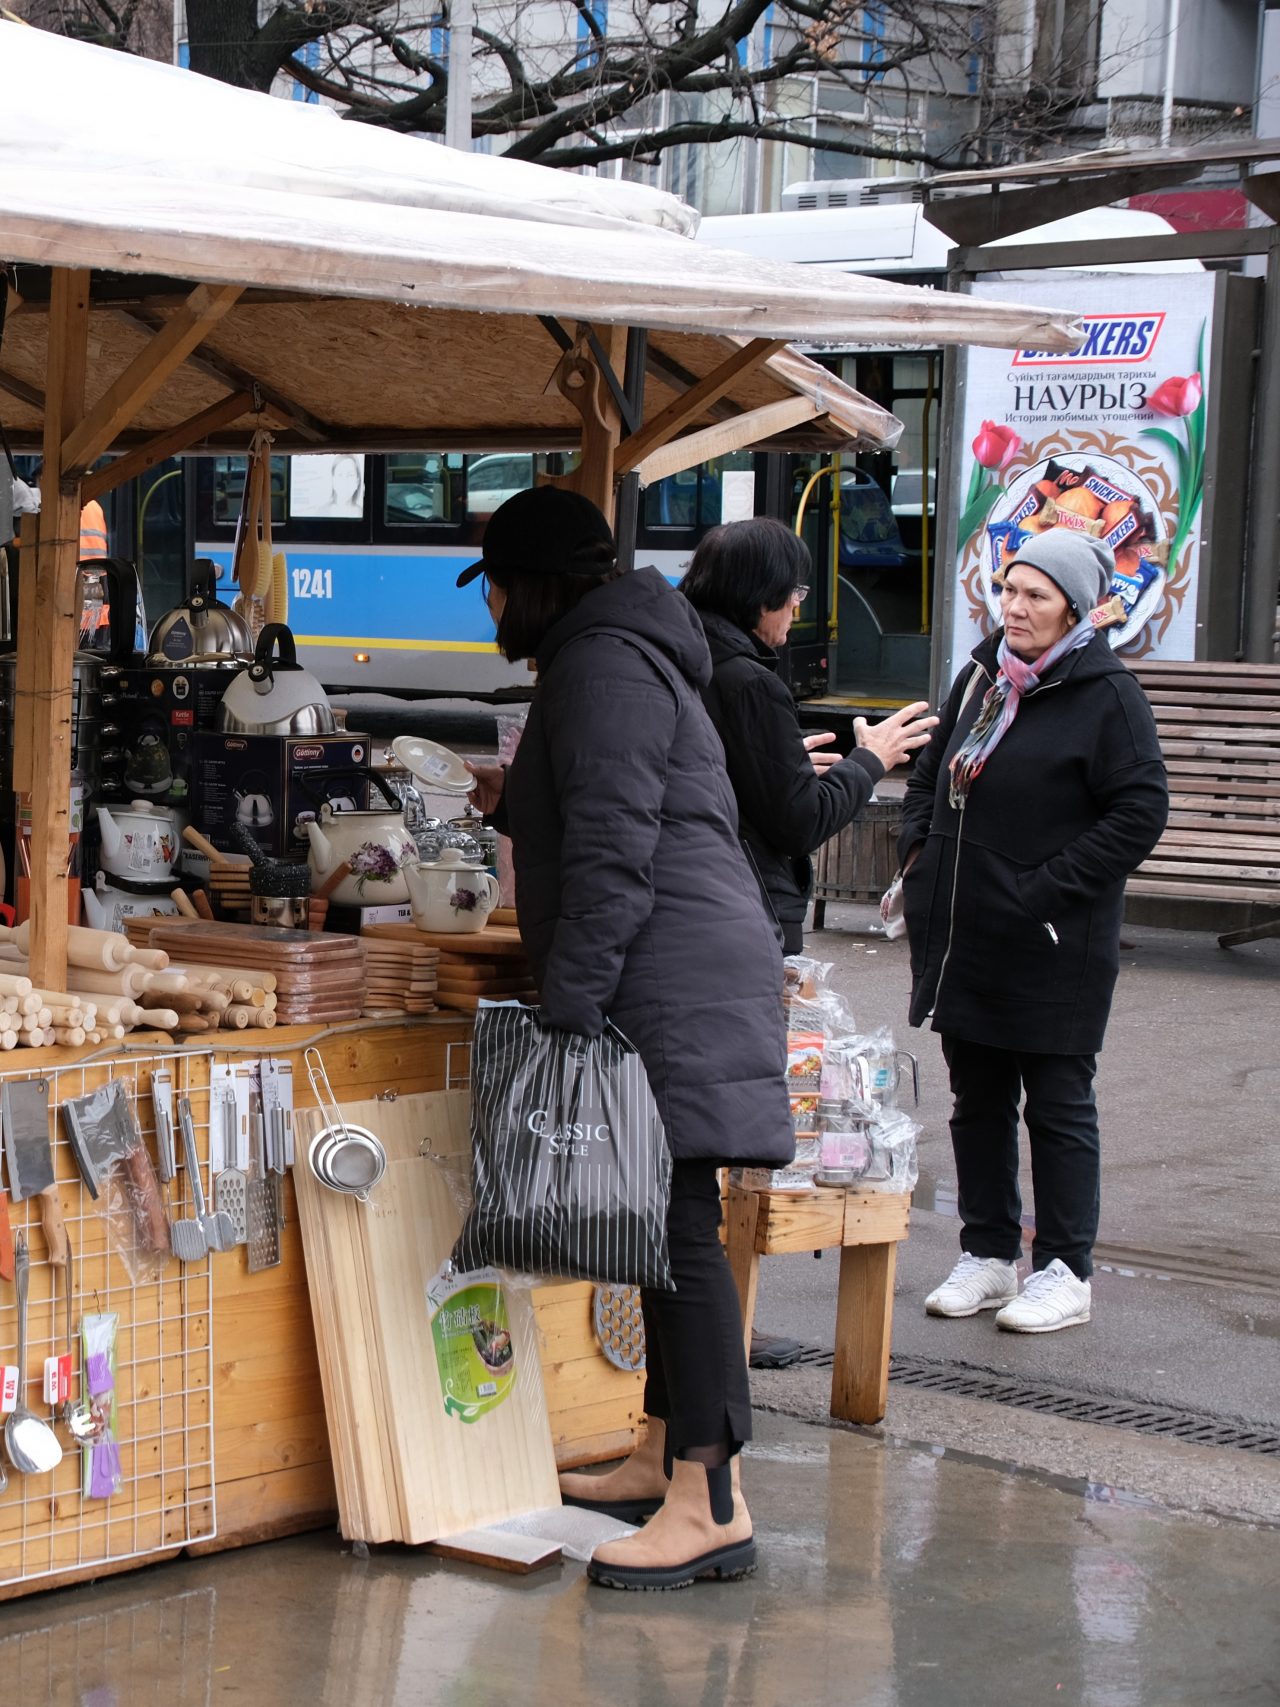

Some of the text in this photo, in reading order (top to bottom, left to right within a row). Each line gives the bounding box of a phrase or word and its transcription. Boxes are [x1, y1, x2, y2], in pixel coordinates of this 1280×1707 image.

[1023, 320, 1156, 358] KERS
[1007, 371, 1156, 383] Сүйікті тағамдардың тарихы
[1014, 382, 1148, 411] НАУРЫЗ
[1005, 411, 1154, 424] История любимых угощений
[292, 568, 332, 598] 1241
[398, 909, 406, 917] TEA
[527, 1109, 610, 1142] CLASSIC
[548, 1135, 589, 1157] STYLE
